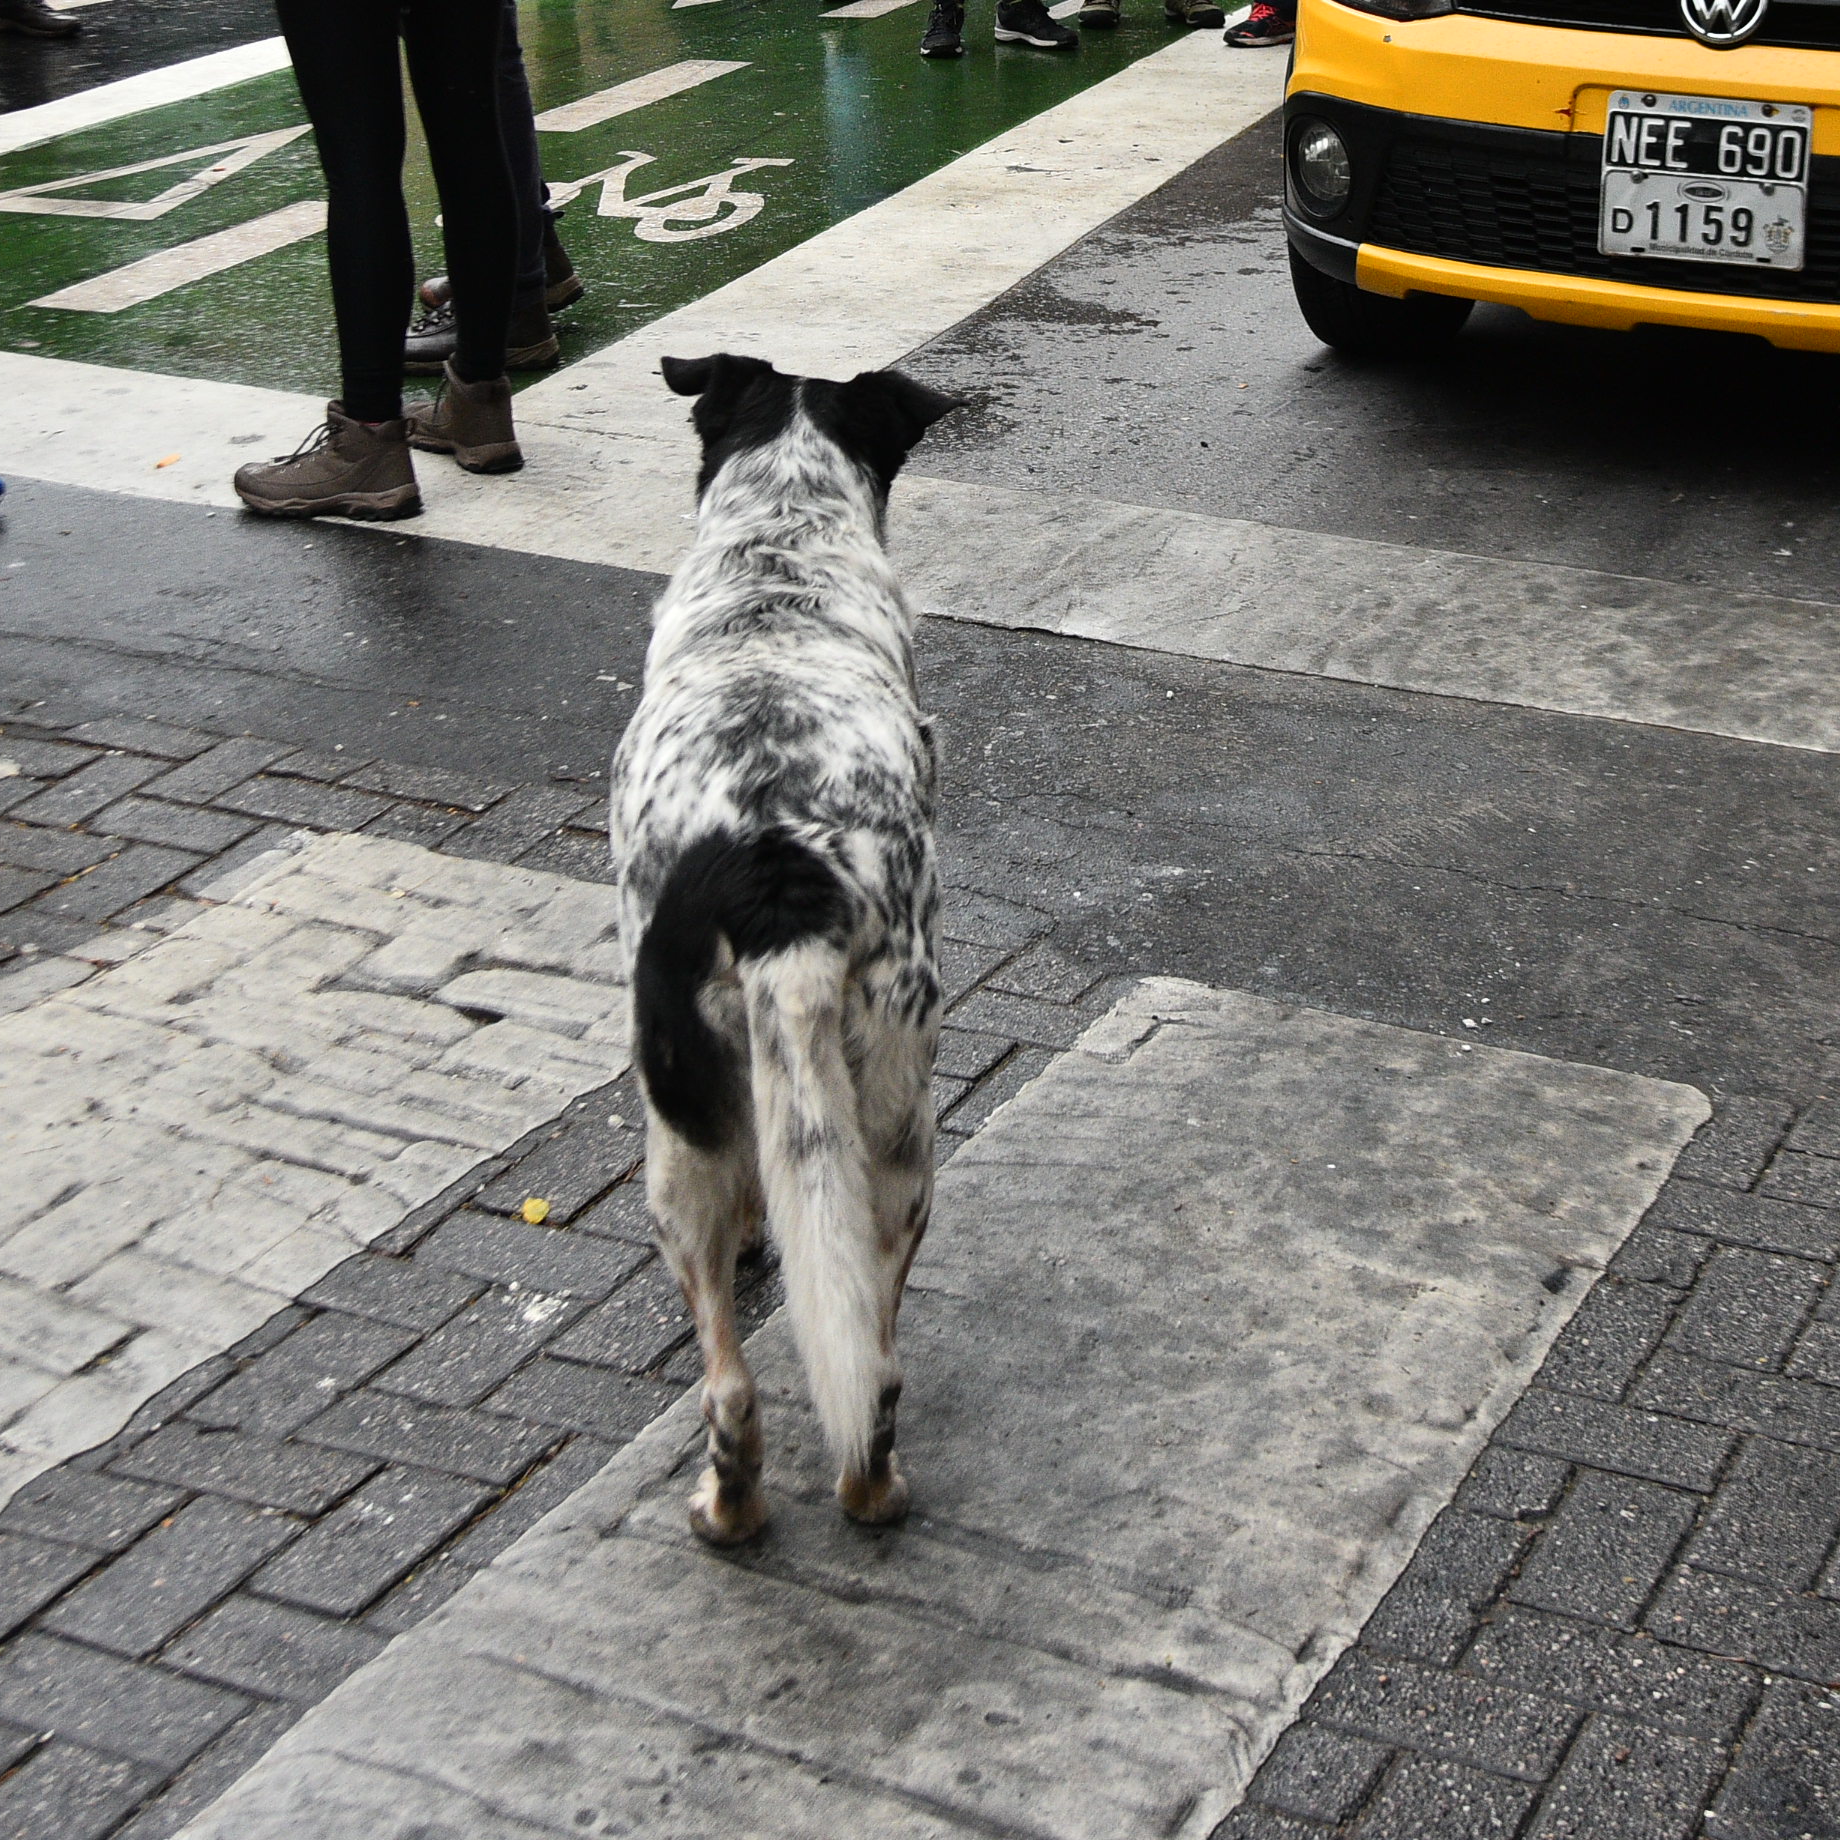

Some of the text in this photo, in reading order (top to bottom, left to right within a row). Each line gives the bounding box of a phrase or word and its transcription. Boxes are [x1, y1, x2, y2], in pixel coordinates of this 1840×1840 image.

[1669, 99, 1749, 117] ARGENTINA
[1610, 114, 1802, 179] NEE 690
[1611, 200, 1754, 247] D 1159
